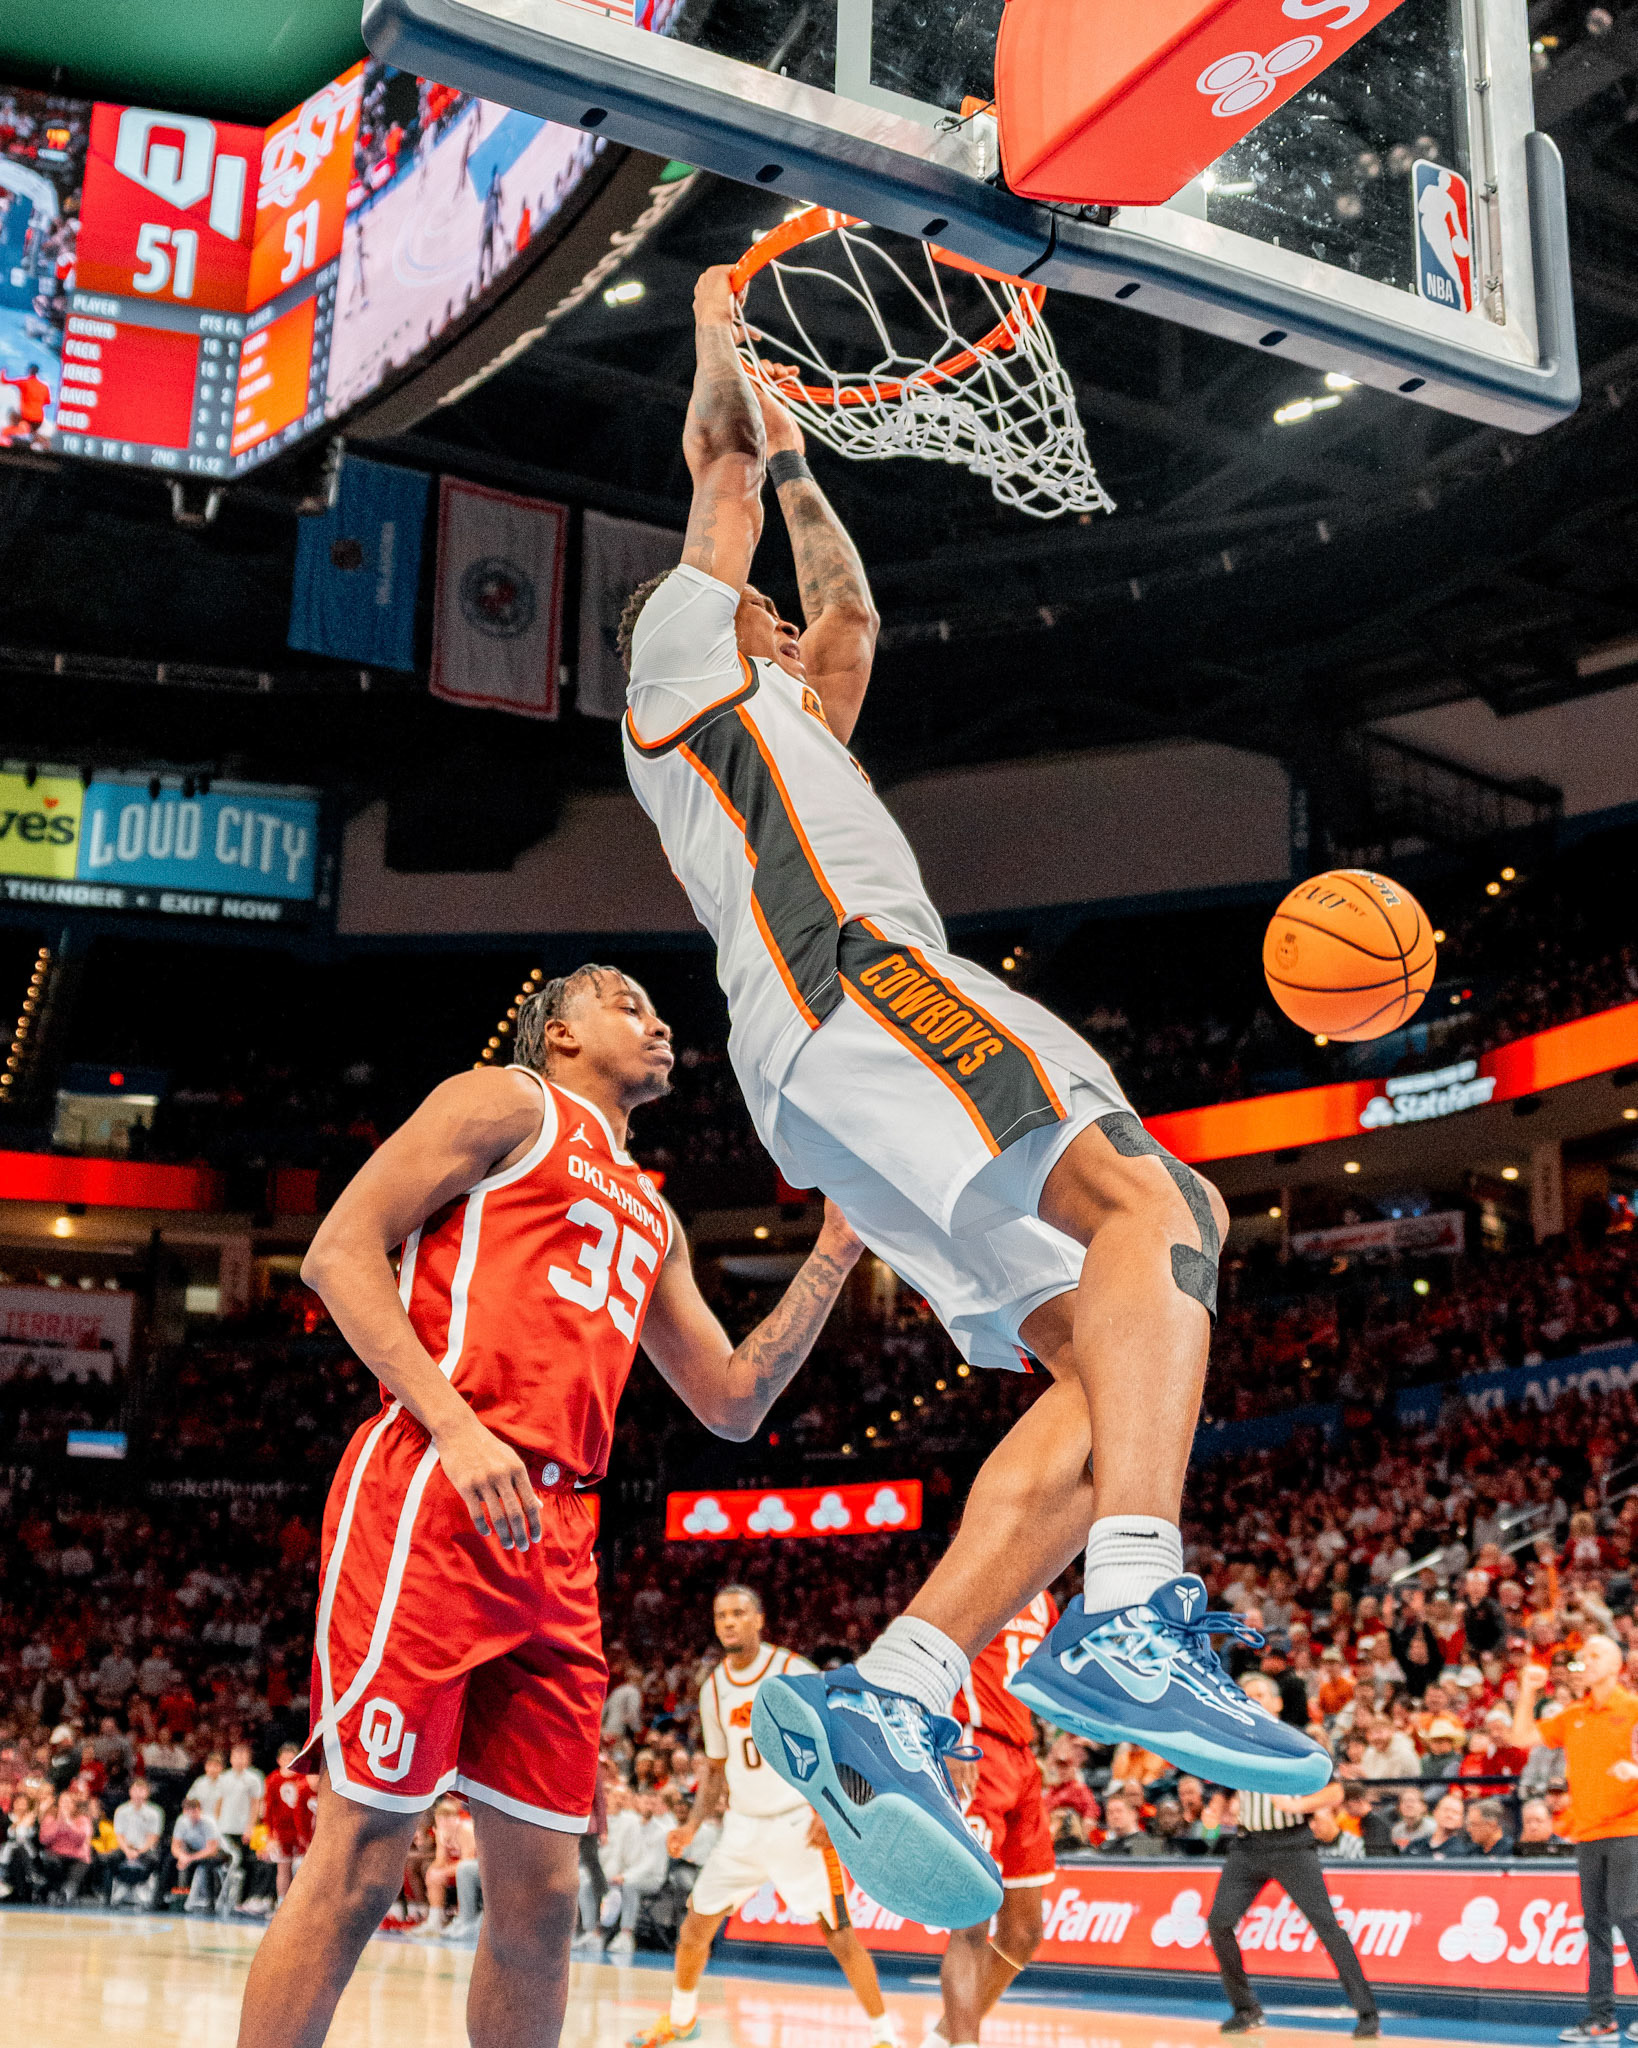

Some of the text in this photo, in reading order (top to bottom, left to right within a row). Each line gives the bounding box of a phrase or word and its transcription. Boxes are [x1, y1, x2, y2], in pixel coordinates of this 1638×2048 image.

[132, 223, 198, 298] 51
[281, 200, 320, 283] 51
[1426, 272, 1455, 304] NBA
[68, 317, 116, 340] BROWN
[73, 294, 120, 316] PLAYER
[200, 314, 224, 332] PTS
[64, 363, 102, 384] JONES
[60, 386, 98, 407] DAVIS
[151, 449, 180, 467] 2ND
[89, 801, 307, 883] LOUD CITY
[5, 880, 281, 921] THUNDER EXIT NOW
[860, 953, 1003, 1076] COWBOYS
[568, 1155, 664, 1247] OKLAHOMA
[548, 1197, 658, 1344] 35
[359, 1697, 416, 1782] OU
[744, 1736, 762, 1769] 0
